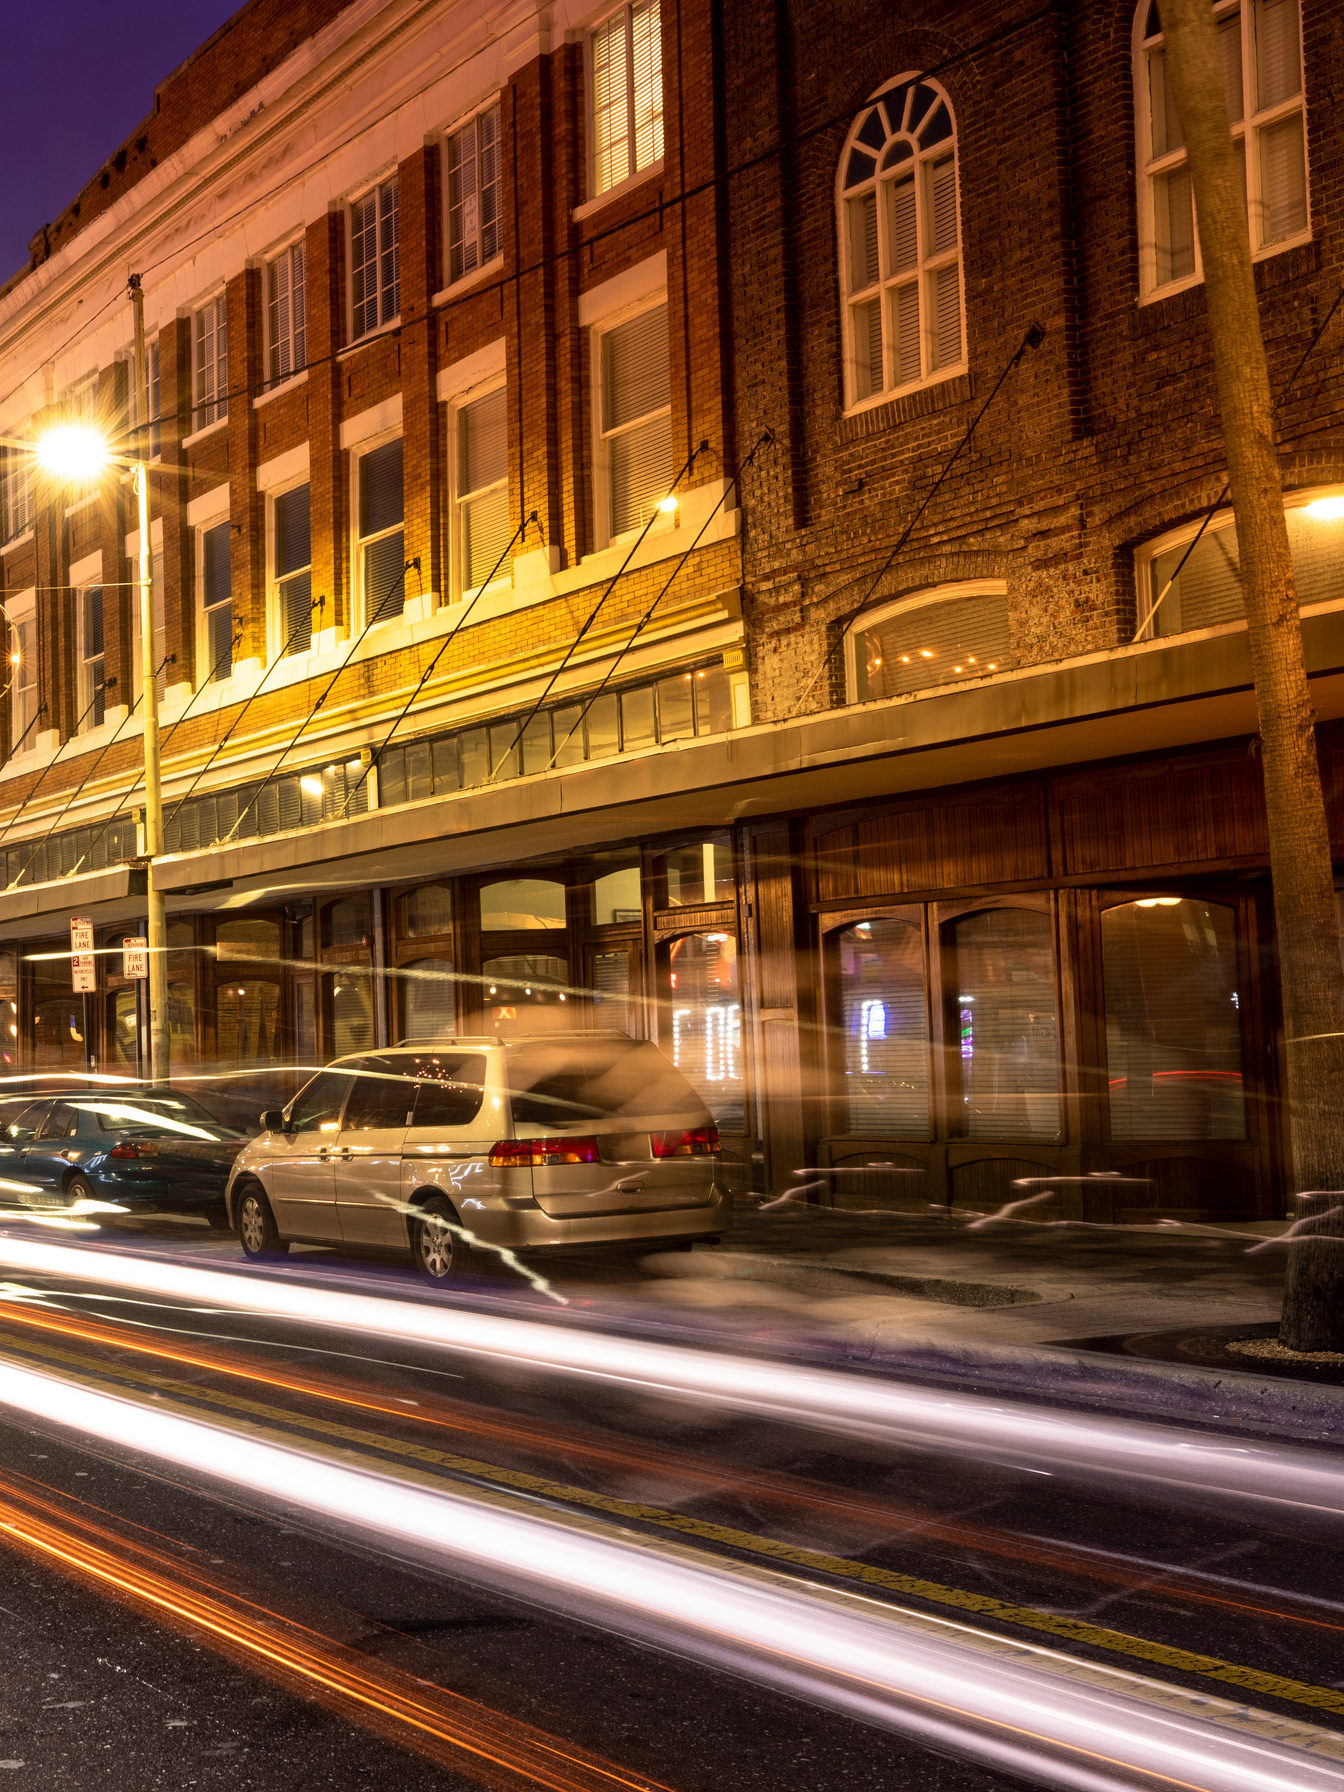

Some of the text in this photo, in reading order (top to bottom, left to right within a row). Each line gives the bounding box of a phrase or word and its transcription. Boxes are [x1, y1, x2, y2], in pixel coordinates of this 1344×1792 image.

[75, 941, 90, 949] LANE
[73, 957, 79, 965] 2
[129, 954, 142, 962] FIRE
[127, 964, 144, 972] LANE
